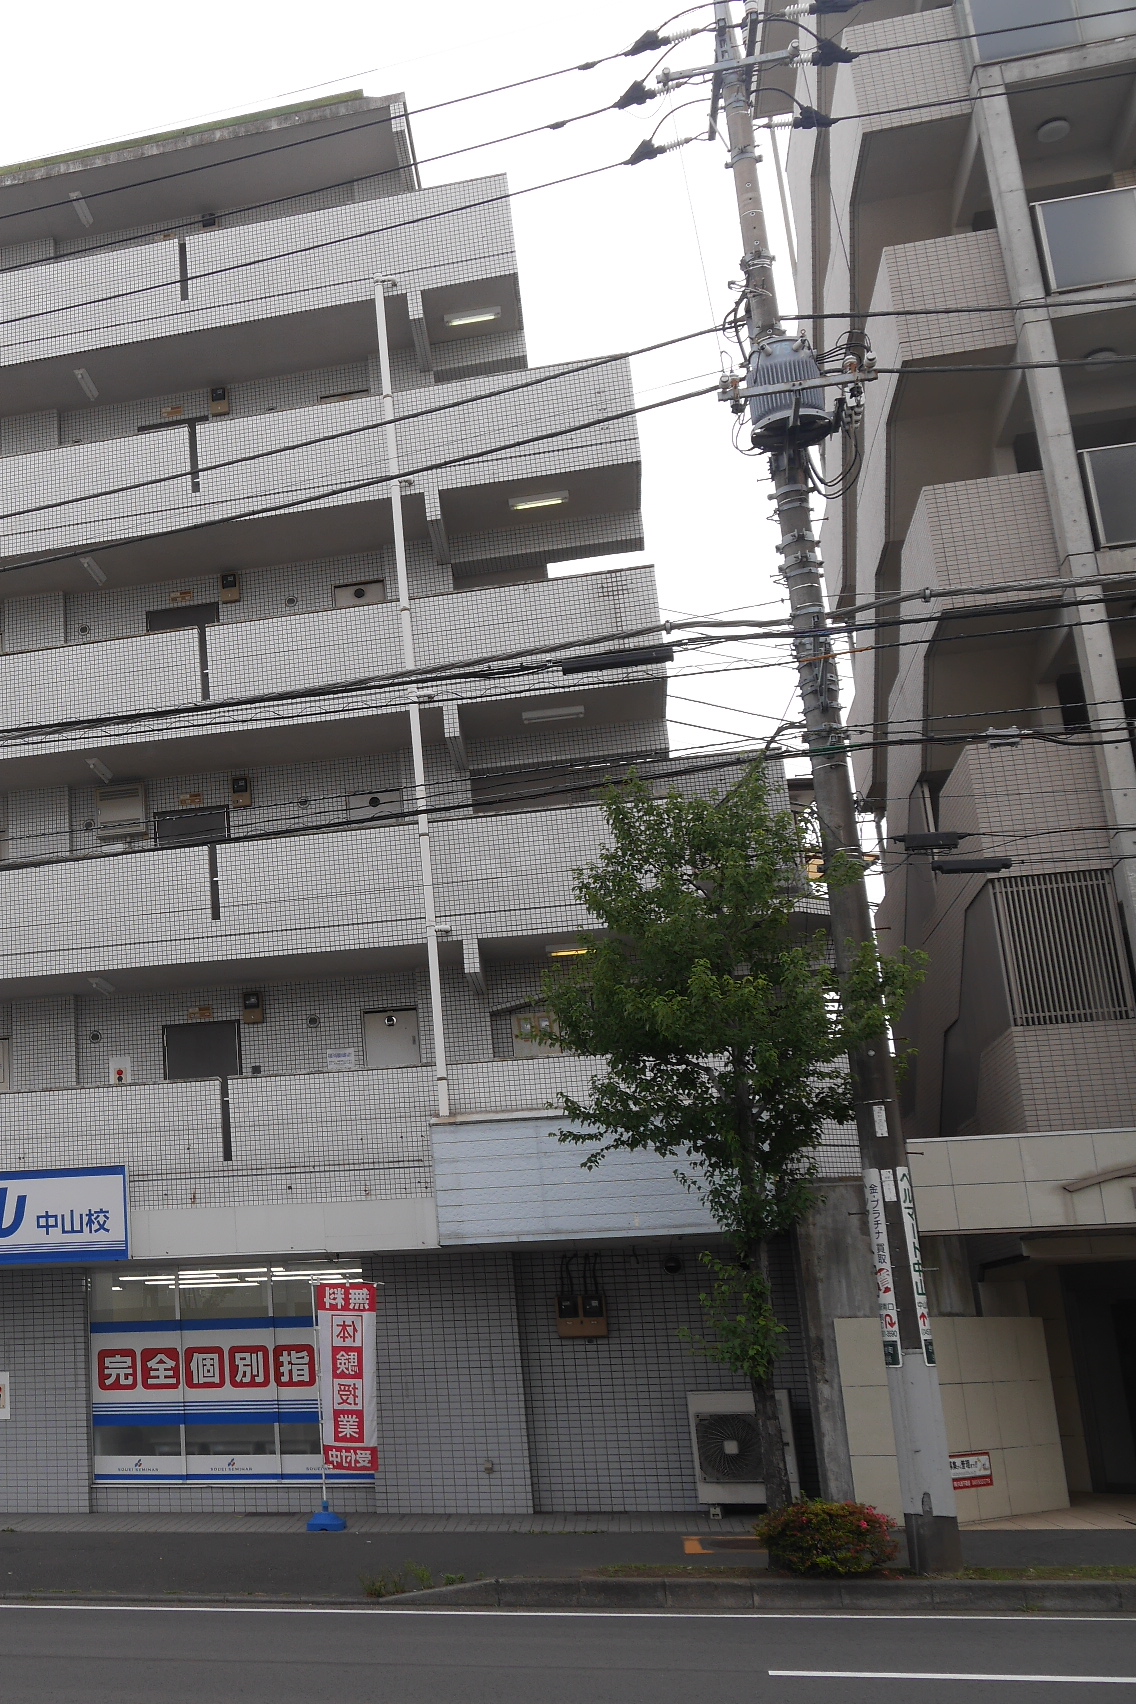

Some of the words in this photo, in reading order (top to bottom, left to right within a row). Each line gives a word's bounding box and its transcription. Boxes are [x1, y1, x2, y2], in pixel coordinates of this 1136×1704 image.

[36, 1208, 111, 1236] 中山校
[104, 1350, 310, 1386] 完全個別指
